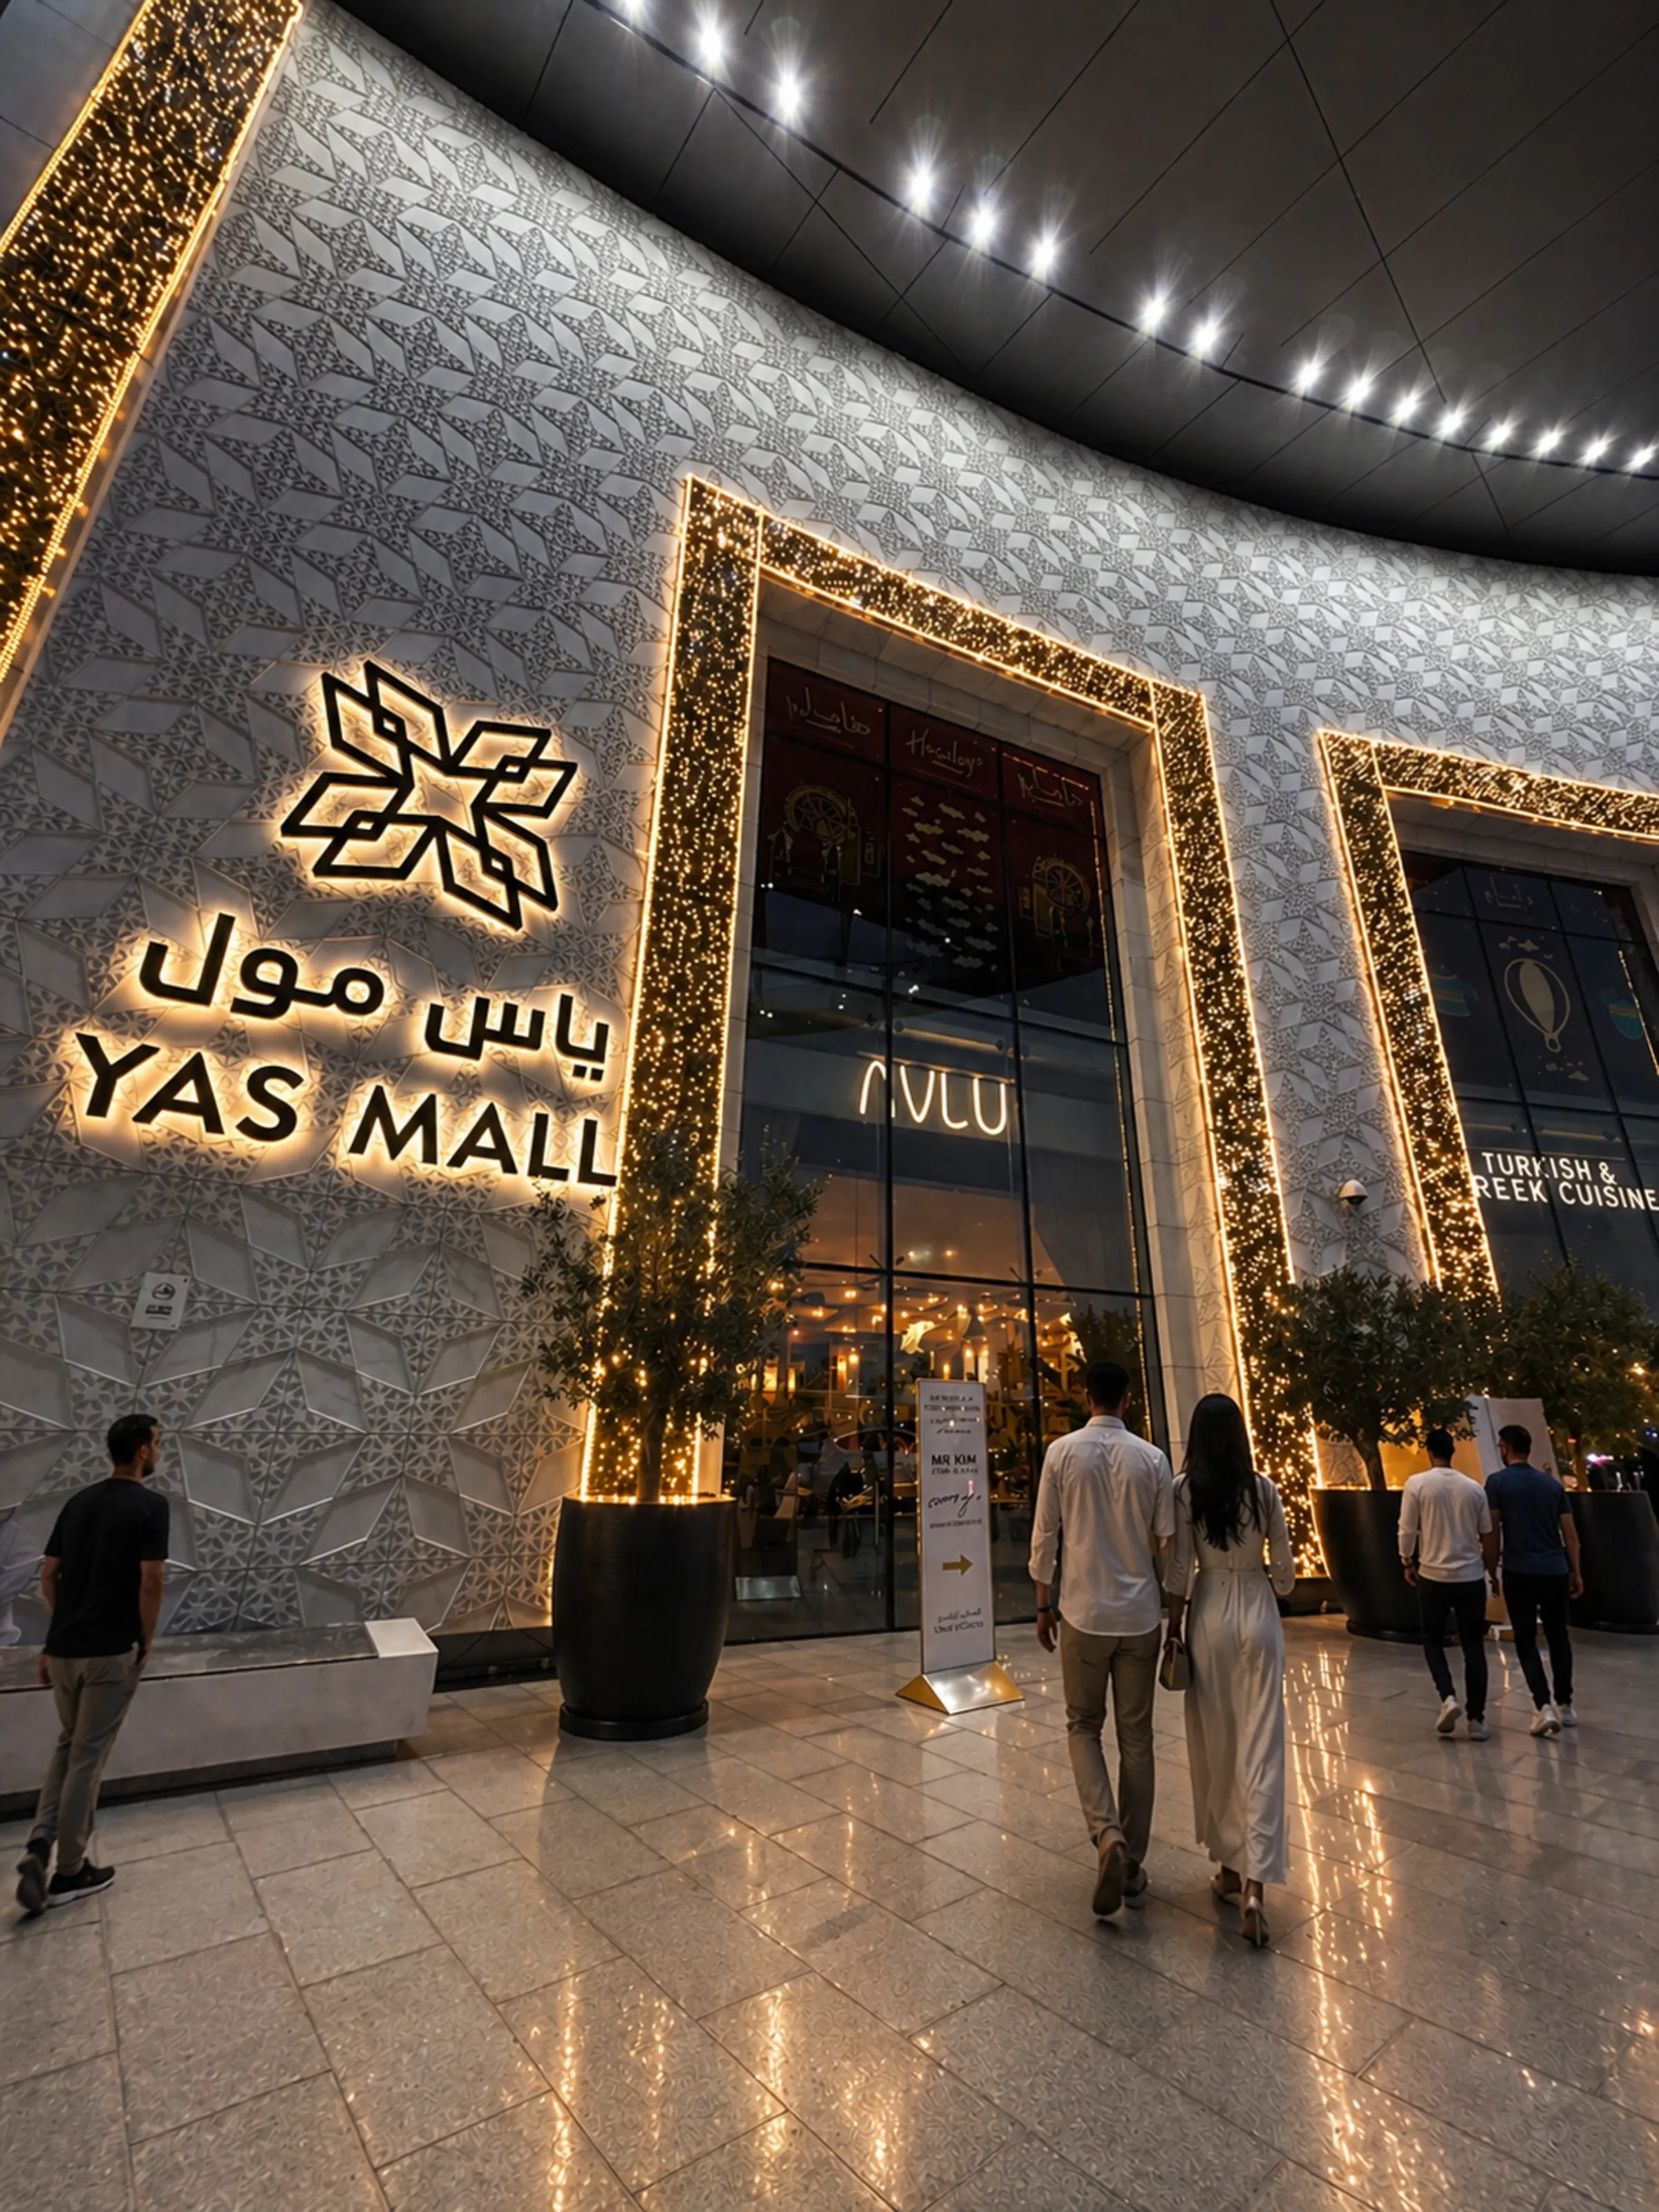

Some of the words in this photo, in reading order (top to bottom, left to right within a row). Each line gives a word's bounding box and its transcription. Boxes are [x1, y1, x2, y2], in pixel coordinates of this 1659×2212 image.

[138, 912, 384, 1020] مول
[422, 993, 611, 1082] ياس
[74, 1031, 304, 1142] YAS
[348, 1084, 617, 1188] MALL
[1465, 1174, 1548, 1203] REEK
[1558, 1181, 1659, 1212] CUISINE
[1481, 1152, 1592, 1182] TURKISH
[1599, 1161, 1618, 1185] &
